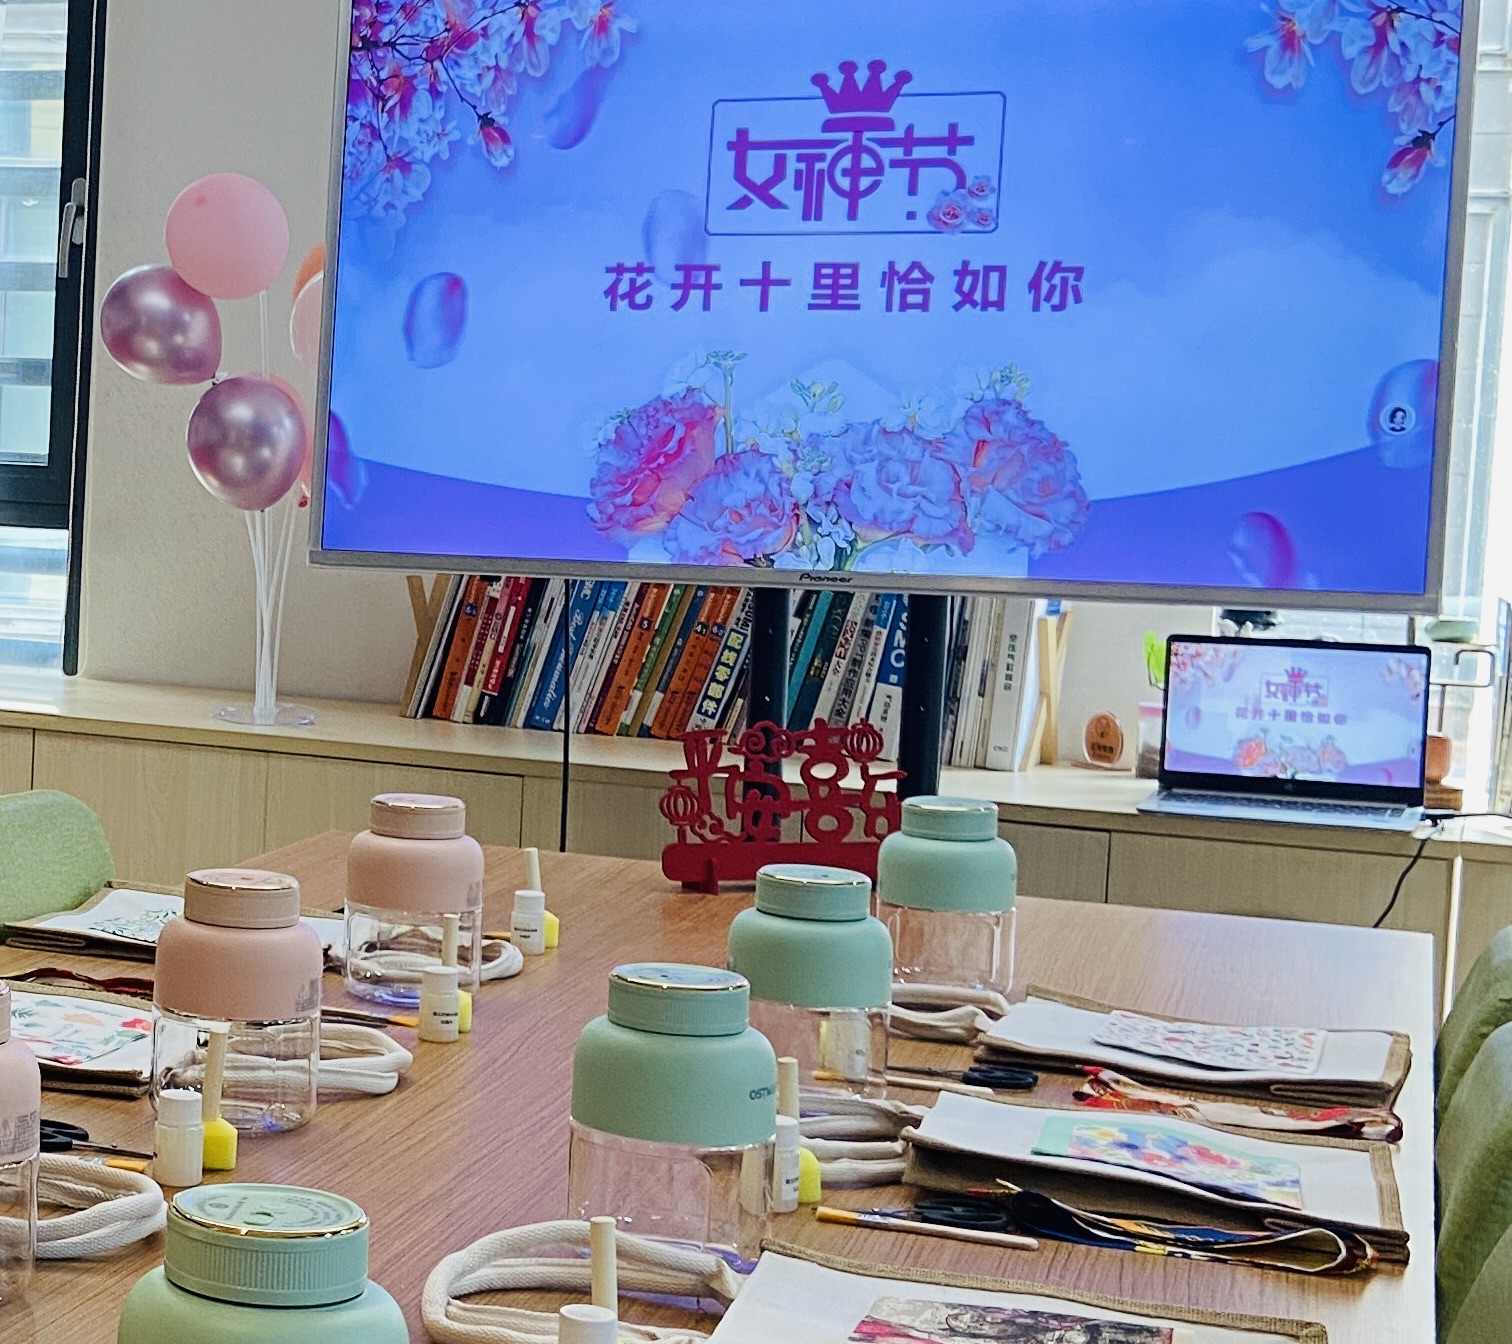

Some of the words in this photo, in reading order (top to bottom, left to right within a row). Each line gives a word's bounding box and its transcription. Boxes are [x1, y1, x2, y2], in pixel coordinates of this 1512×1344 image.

[726, 115, 975, 221] 女神节
[602, 258, 1085, 313] 花开十里恰如你
[799, 572, 854, 584] Pioneer
